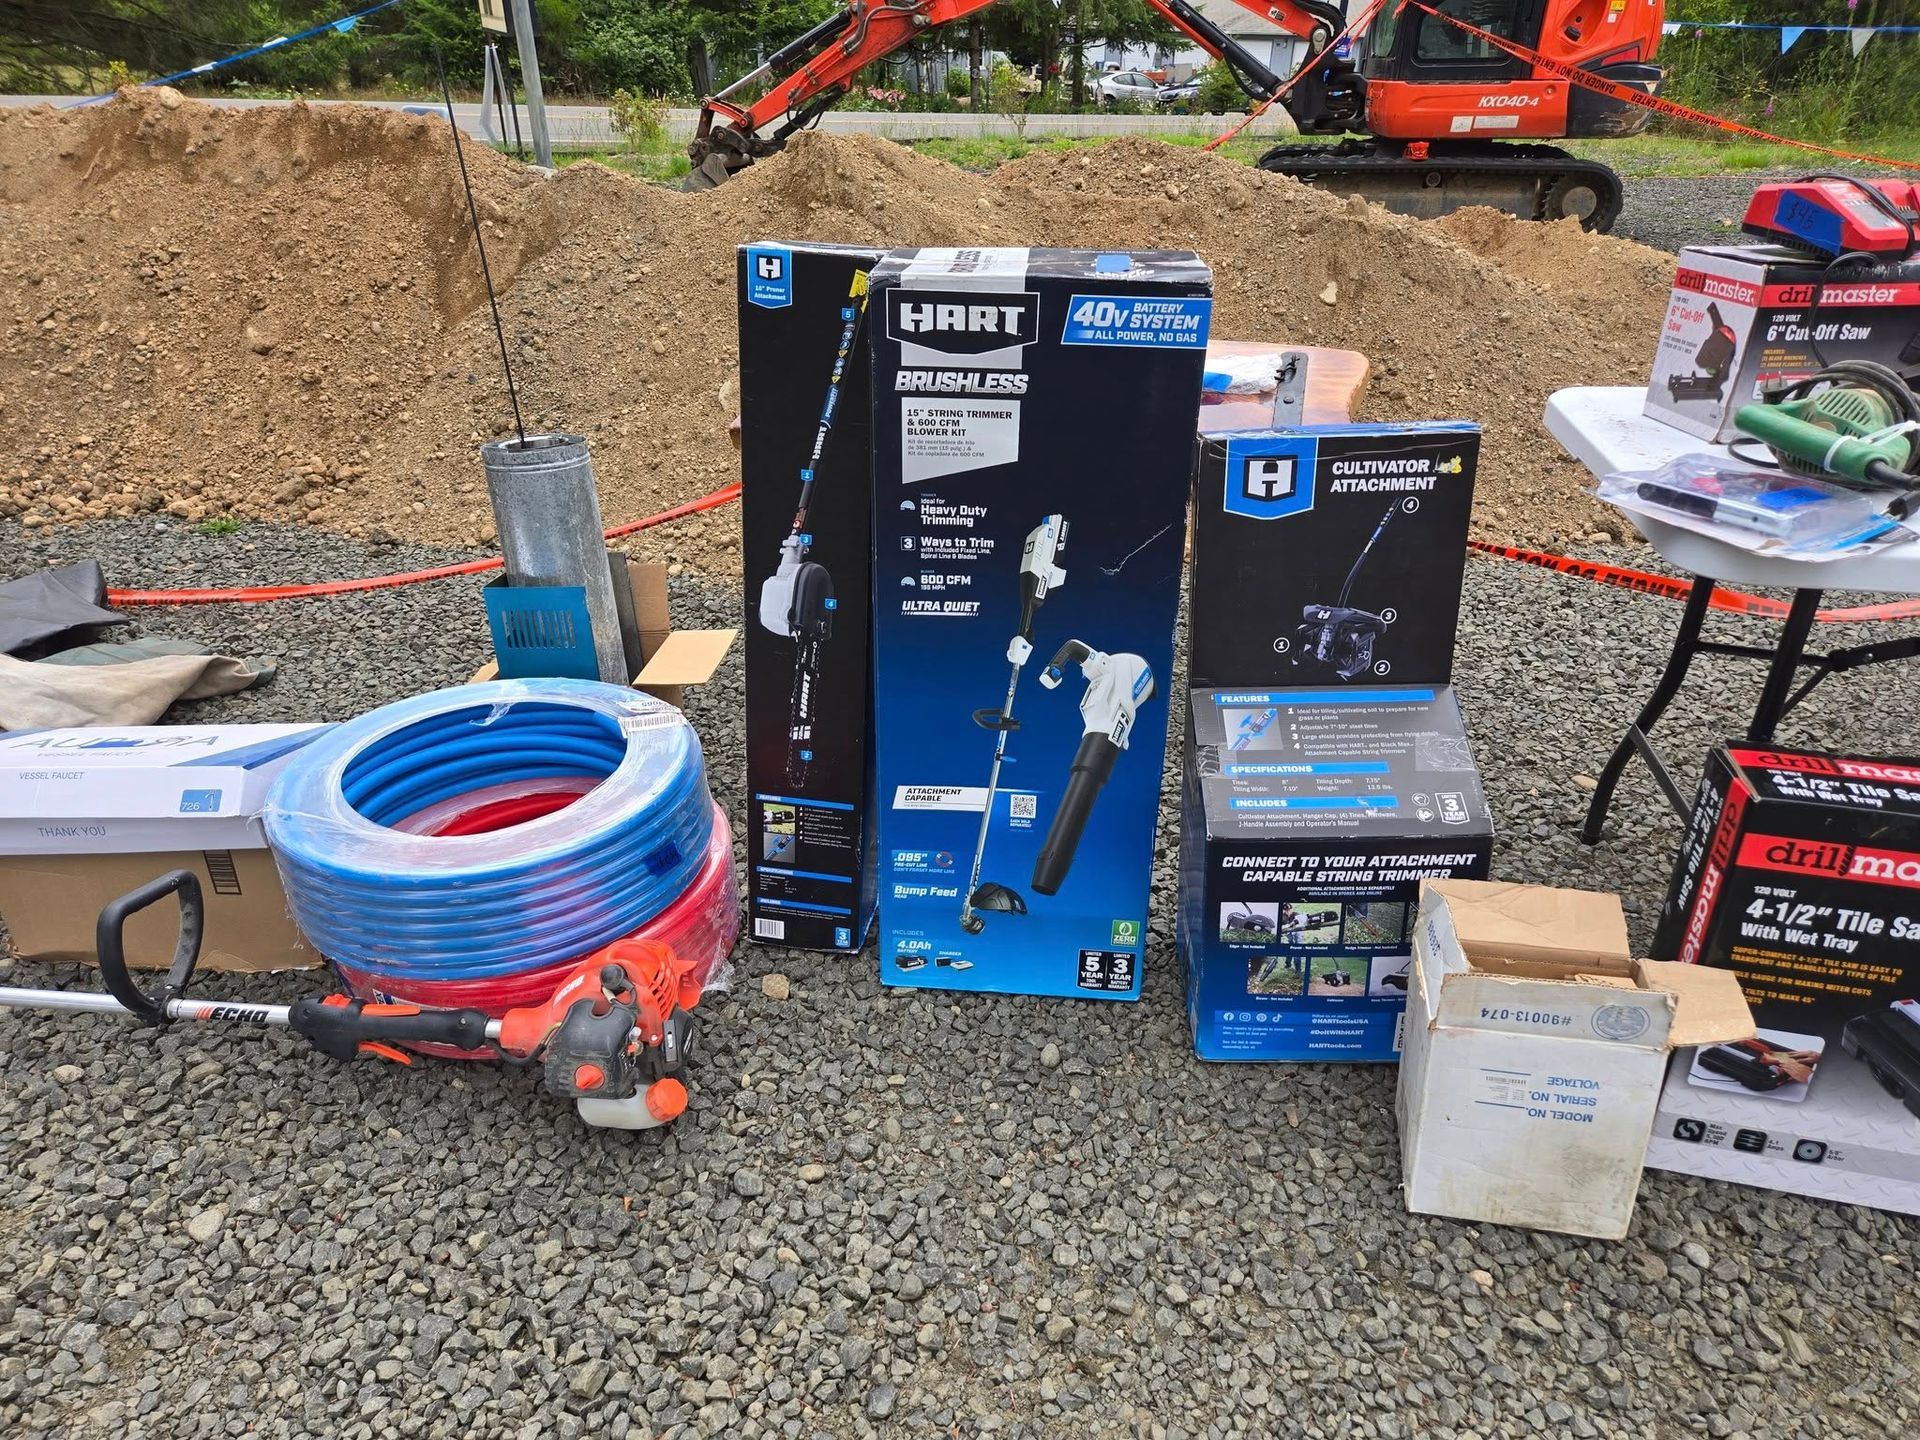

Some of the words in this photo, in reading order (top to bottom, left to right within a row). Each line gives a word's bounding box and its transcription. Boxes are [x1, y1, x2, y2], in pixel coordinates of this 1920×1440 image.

[1531, 54, 1555, 71] ENTER
[1556, 65, 1573, 77] NOT
[1573, 71, 1584, 81] DO
[1585, 78, 1616, 94] DANGER
[1478, 95, 1539, 107] KX040-4
[1631, 92, 1658, 108] ENTER
[1657, 103, 1675, 114] NOT
[1675, 108, 1688, 119] DO
[1689, 112, 1721, 127] DANGER
[759, 257, 780, 278] H
[754, 292, 786, 300] Attachment
[1820, 285, 1898, 303] master
[1134, 303, 1184, 314] BATTERY
[900, 303, 1025, 335] HART
[1130, 314, 1199, 330] SYSTEM
[1785, 314, 1801, 322] VOLT
[1667, 319, 1682, 333] Saw
[1767, 325, 1786, 341] 6"
[1839, 323, 1871, 340] Saw
[1095, 330, 1114, 340] ALL
[1116, 330, 1156, 343] POWER,
[1159, 331, 1174, 342] NO
[1176, 332, 1197, 343] GAS
[894, 370, 1029, 394] BRUSHLESS
[907, 408, 924, 417] 15"
[928, 409, 963, 418] STRING
[966, 410, 1012, 419] TRIMMER
[907, 419, 915, 427] &
[918, 419, 936, 427] 600
[939, 419, 960, 427] CFM
[907, 428, 948, 436] BLOWER
[951, 428, 967, 437] KIT
[812, 426, 827, 459] HART
[1332, 459, 1430, 475] CULTIVATOR
[1248, 459, 1293, 497] H
[1330, 476, 1437, 492] ATTACHMENT
[921, 504, 957, 516] Heavy
[960, 505, 988, 518] Duty
[921, 514, 974, 527] Trimming
[903, 539, 913, 549] 3
[921, 537, 952, 549] Ways
[955, 537, 967, 547] to
[969, 538, 994, 548] Trim
[946, 575, 971, 585] CFM
[902, 600, 940, 611] ULTRA
[943, 601, 980, 613] QUIET
[800, 671, 810, 719] HART
[1221, 695, 1270, 703] FEATURES
[19, 772, 50, 780] VESSEL
[51, 771, 84, 780] FAUCET
[1231, 765, 1313, 773] SPECIFICATIONS
[906, 788, 962, 796] ATTACHMENT
[1777, 786, 1815, 799] With
[1816, 790, 1849, 802] Wet
[1848, 794, 1883, 807] Tray
[1844, 782, 1891, 798] Tile
[181, 801, 200, 811] 726
[1236, 799, 1287, 807] INCLUDES
[1306, 820, 1336, 828] Operator's
[37, 827, 80, 838] THANK
[81, 826, 107, 837] YOU
[1222, 856, 1297, 868] CONNECT
[1300, 856, 1320, 867] TO
[1324, 856, 1366, 867] YOUR
[1368, 854, 1477, 867] ATTACHMENT
[1688, 842, 1704, 874] Tile
[1242, 871, 1313, 882] CAPABLE
[1316, 870, 1374, 882] STRING
[1378, 869, 1452, 881] TRIMMER
[894, 885, 927, 897] Bump
[930, 887, 957, 897] Feed
[1677, 874, 1694, 911] Saw
[1754, 885, 1771, 895] 120
[1773, 887, 1797, 898] VOLT
[1681, 863, 1720, 963] maste
[1746, 898, 1833, 926] 4-1/2"
[1836, 908, 1885, 935] Tile
[1741, 922, 1780, 940] With
[1784, 928, 1819, 946] Wet
[1823, 933, 1859, 953] Tray
[897, 940, 932, 950] 4.0Ah
[1085, 956, 1100, 972] 5
[1113, 959, 1128, 974] 3
[1731, 953, 1775, 966] TRANSPORT
[1776, 959, 1793, 969] AND
[1828, 967, 1844, 976] ANY
[1846, 969, 1865, 980] TYPE
[1866, 972, 1878, 981] OF
[1879, 975, 1897, 984] TILE
[1824, 957, 1840, 967] TILE
[1841, 960, 1859, 970] SAW
[1860, 962, 1868, 971] IS
[1869, 964, 1890, 975] EASY
[1892, 968, 1903, 976] TO
[1081, 971, 1103, 979] YEAR
[1109, 973, 1131, 981] YEAR
[1778, 976, 1793, 985] FOR
[1794, 978, 1824, 990] MAKING
[1826, 983, 1850, 994] MITER
[1851, 987, 1872, 997] CUTS
[209, 1007, 269, 1023] ECHO
[1480, 1007, 1573, 1026] #90013-074
[1547, 1076, 1600, 1090] VOLTAGE
[1528, 1090, 1550, 1102] NO.
[1553, 1093, 1598, 1107] SERIAL
[1525, 1107, 1547, 1119] NO.
[1550, 1110, 1593, 1123] MODEL
[1767, 1144, 1784, 1152] Amps
